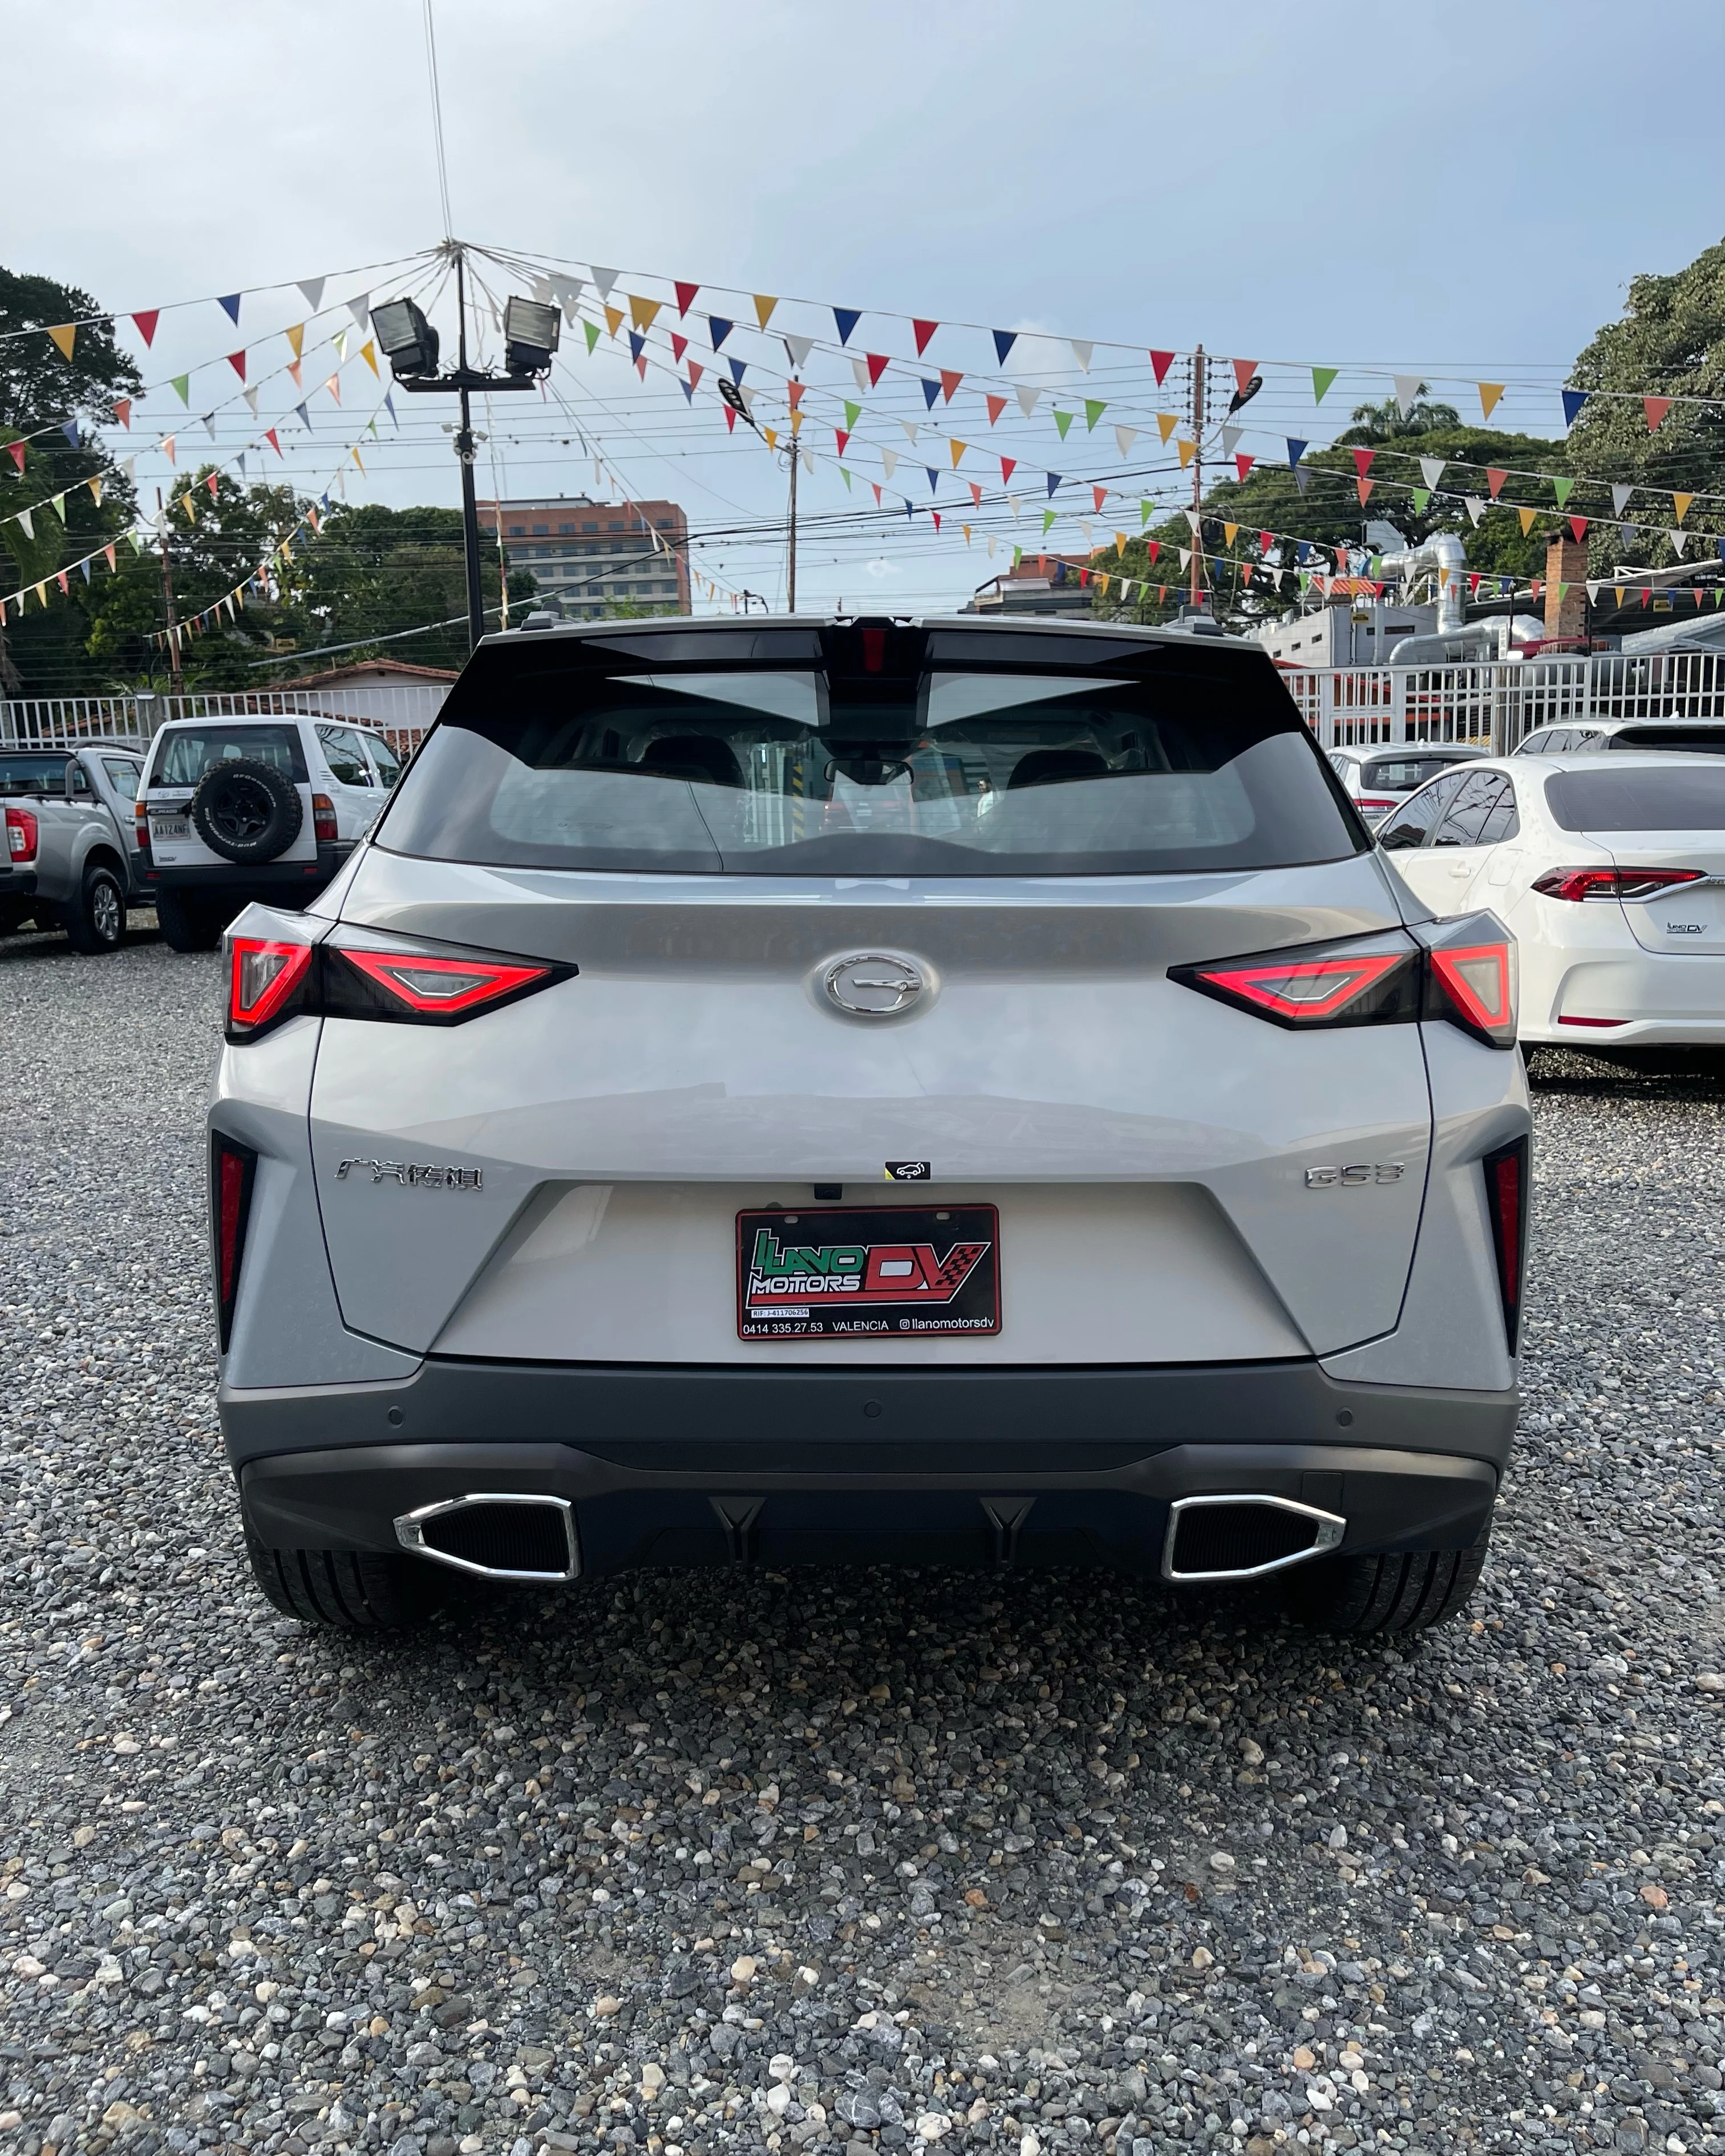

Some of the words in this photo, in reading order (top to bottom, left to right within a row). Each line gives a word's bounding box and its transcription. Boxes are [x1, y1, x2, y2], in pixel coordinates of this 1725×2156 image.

[334, 1158, 483, 1191] 广汽传祺
[1306, 1162, 1405, 1188] GS3
[756, 1232, 864, 1275] LLANO
[865, 1246, 985, 1290] DV
[752, 1274, 861, 1294] MOTORS
[743, 1324, 768, 1335] 0414
[772, 1322, 823, 1334] 335.27.53
[832, 1320, 889, 1332] VALENCIA
[912, 1316, 994, 1330] llanomotorsdv
